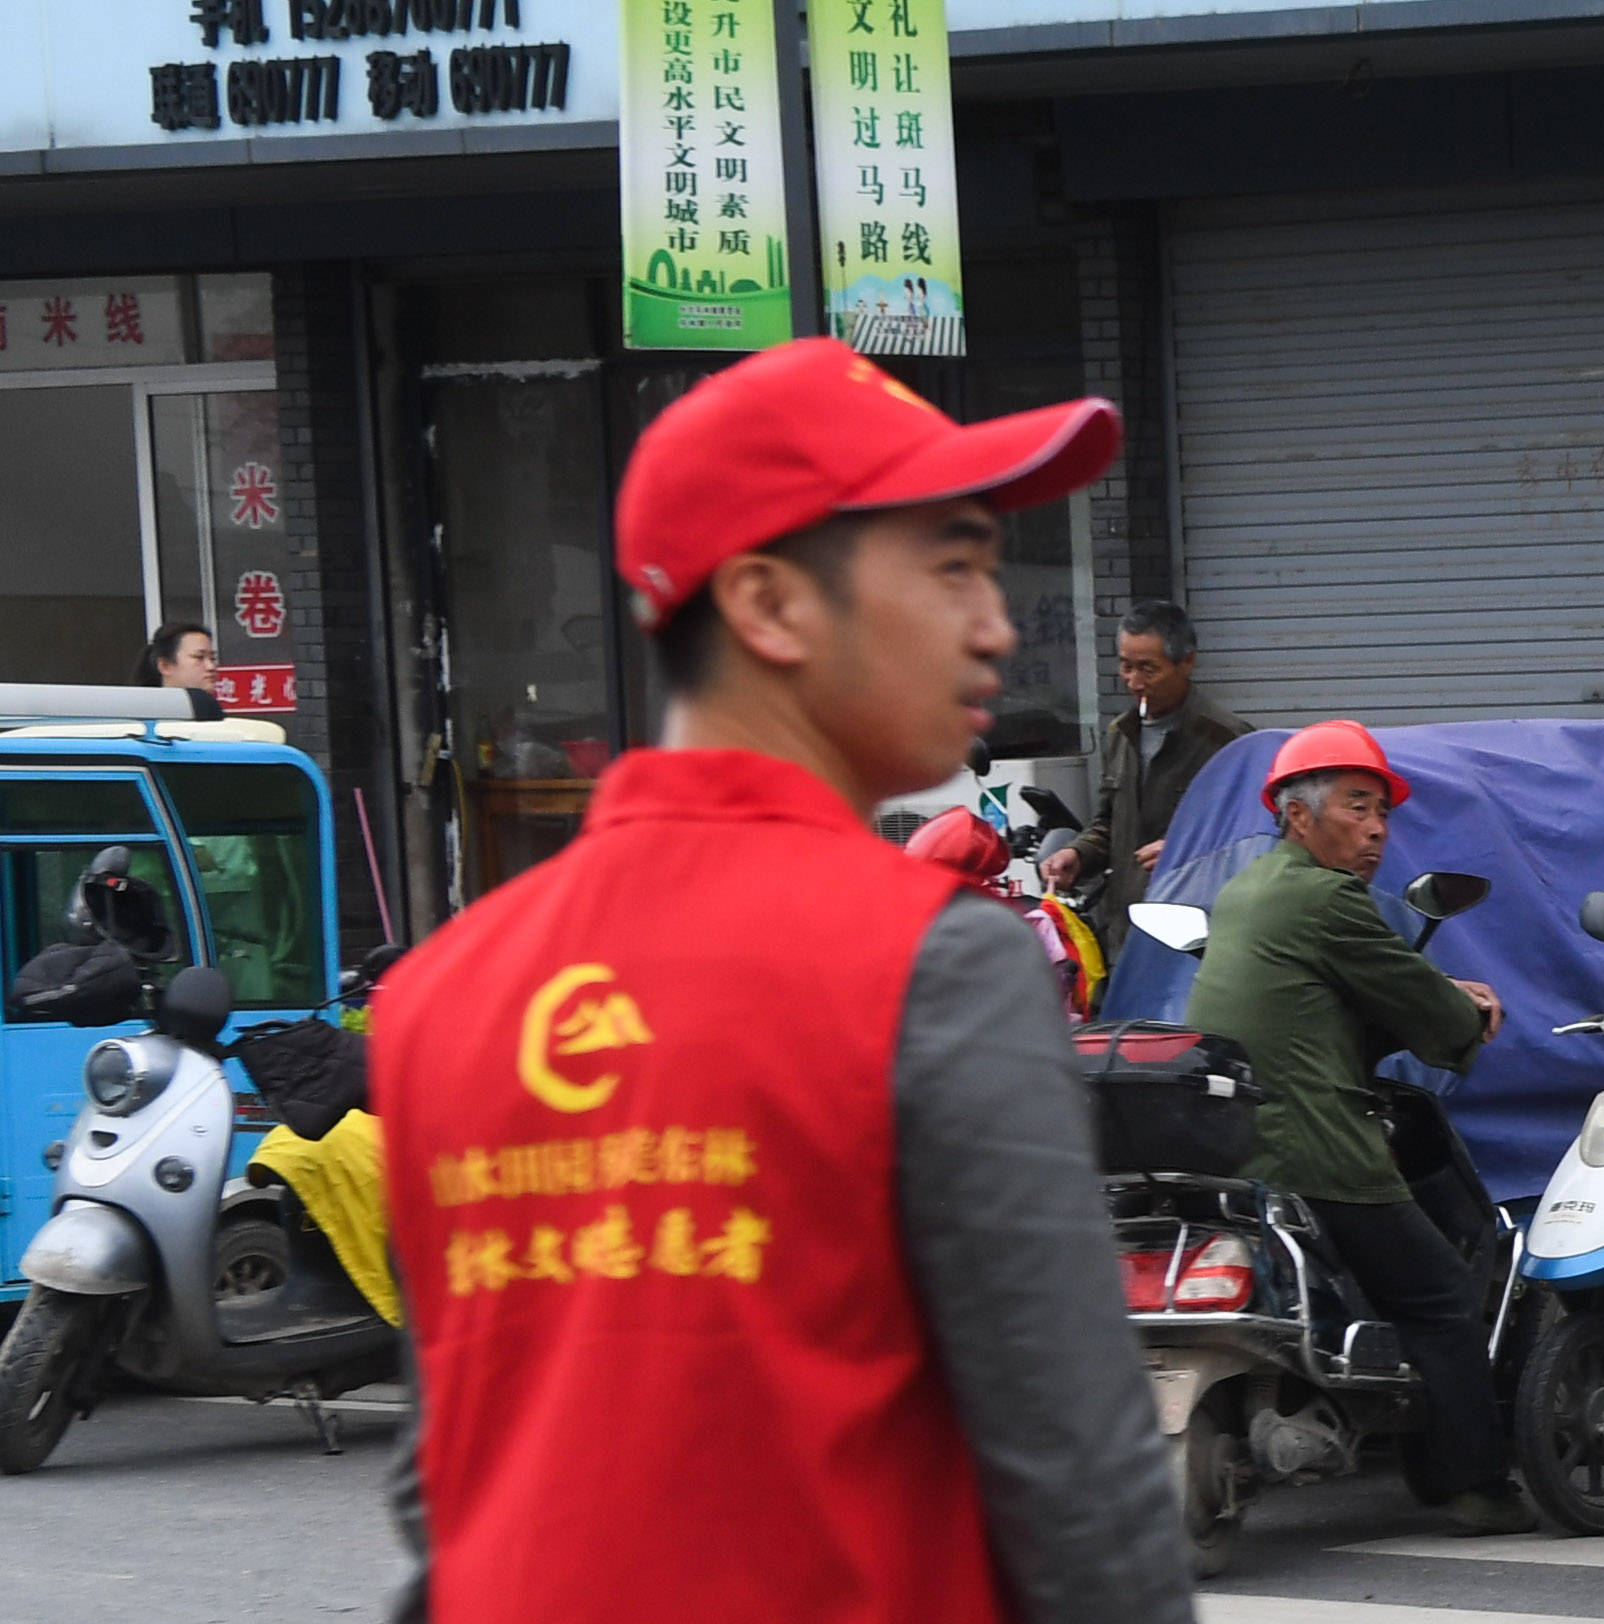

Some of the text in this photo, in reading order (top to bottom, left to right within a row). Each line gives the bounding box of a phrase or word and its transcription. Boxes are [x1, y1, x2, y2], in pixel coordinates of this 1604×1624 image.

[149, 62, 221, 130] 联通
[365, 48, 438, 120] 移动
[661, 0, 701, 254] 设更高水平文明城市
[848, 0, 889, 264] 文明过马路
[888, 0, 932, 266] 礼让斑马线
[0, 293, 145, 349] 米线
[231, 463, 286, 637] 米卷
